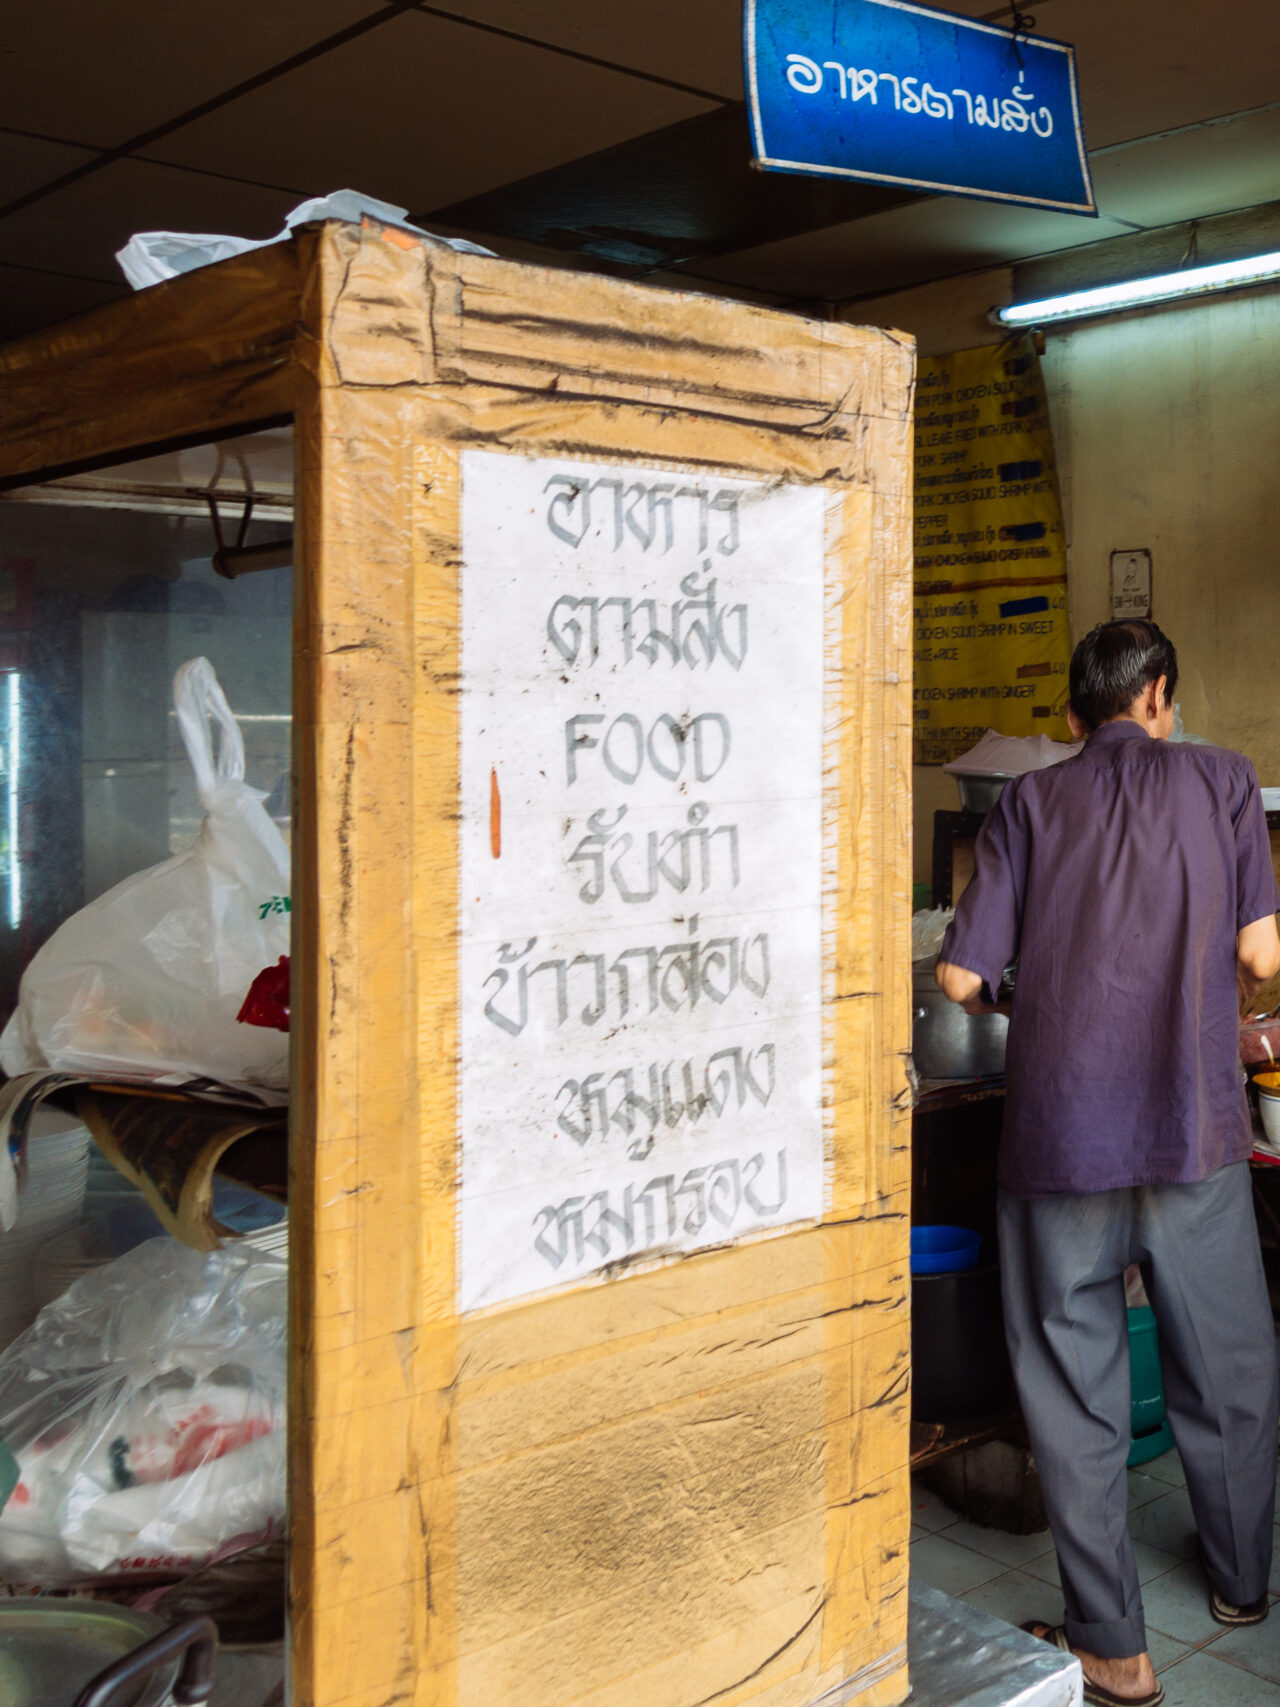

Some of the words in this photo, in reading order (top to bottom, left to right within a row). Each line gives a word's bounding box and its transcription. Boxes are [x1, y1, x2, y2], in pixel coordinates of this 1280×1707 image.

[786, 53, 1053, 138] อาหารตามสั่ง
[542, 473, 740, 556] อาหาร
[546, 558, 748, 671] ตามสั่ง
[1018, 620, 1055, 635] SWEET
[565, 711, 731, 788] FOOD
[567, 801, 740, 904] รับทำ
[481, 912, 772, 1037] ข้าวกล่อง
[554, 1043, 775, 1161] หมูแดง
